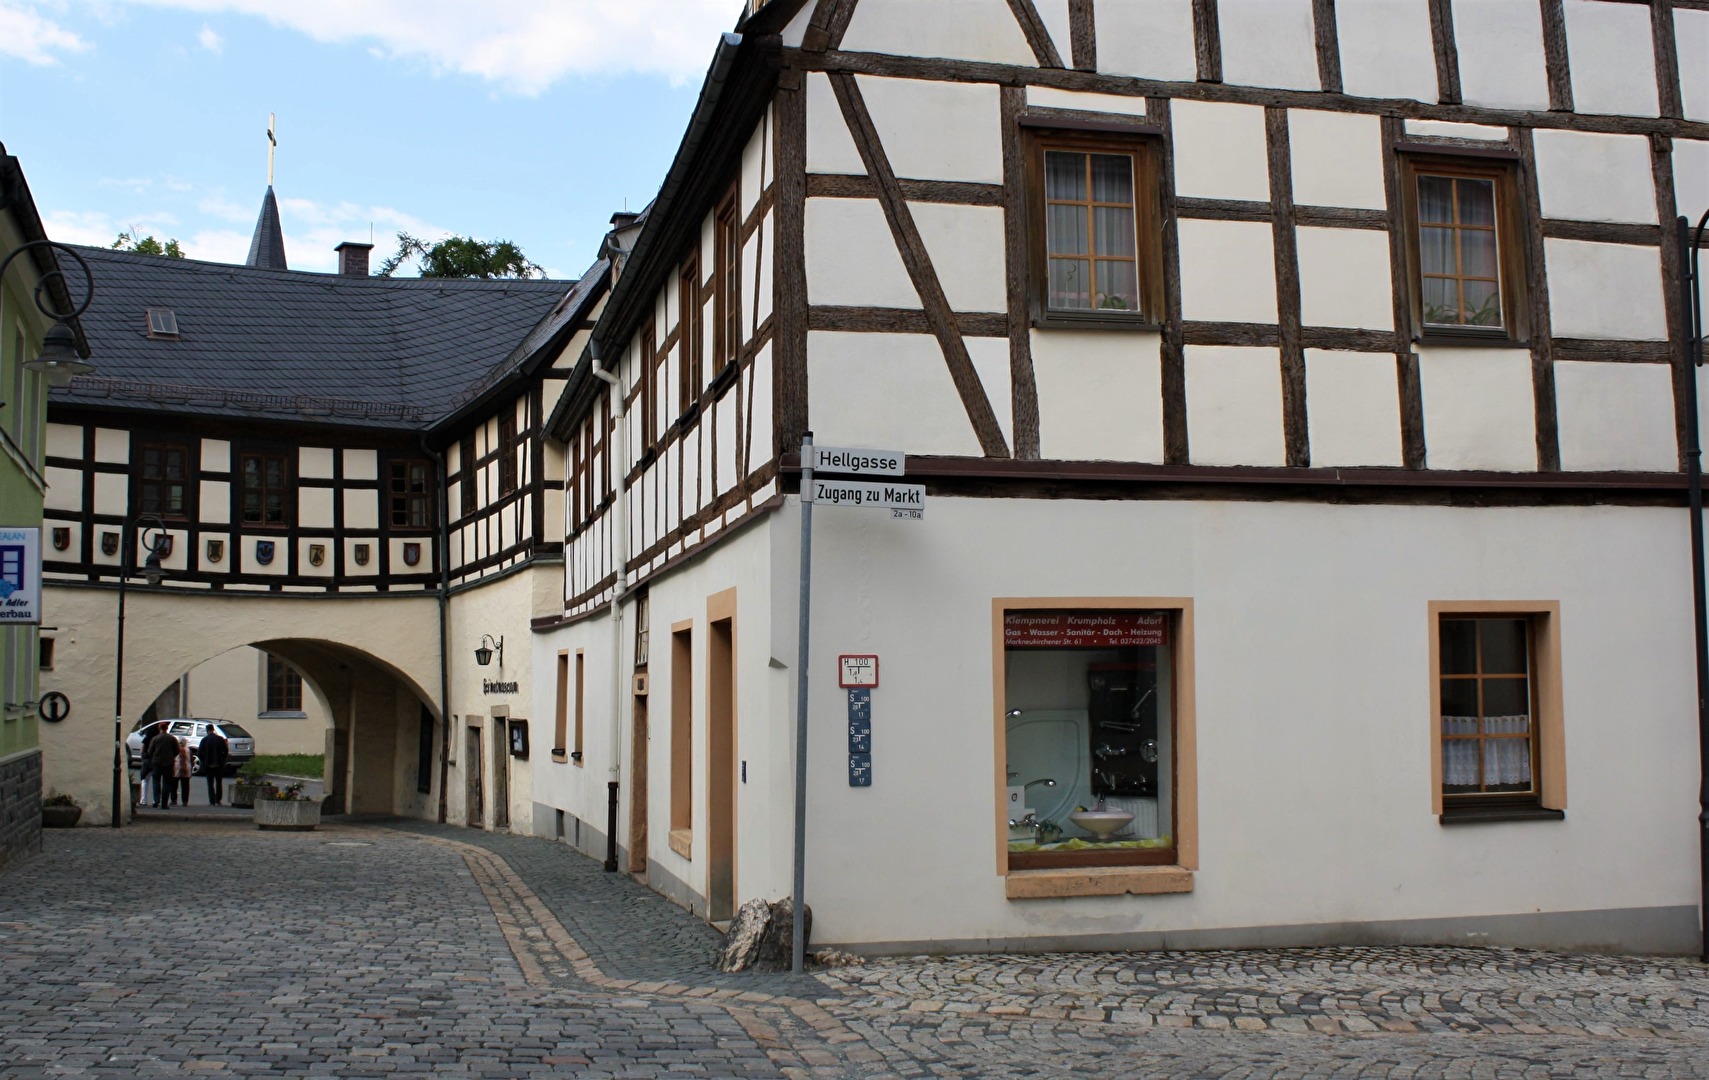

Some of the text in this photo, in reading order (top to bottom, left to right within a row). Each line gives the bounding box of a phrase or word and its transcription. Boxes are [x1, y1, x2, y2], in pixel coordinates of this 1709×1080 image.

[820, 451, 897, 471] Hellgasse
[818, 484, 920, 504] Zugang zu Markt
[893, 510, 903, 518] 2a
[909, 511, 921, 519] 10a
[6, 599, 28, 607] Adler
[1006, 616, 1162, 626] Klempnerei Krumpholz Adorf
[1005, 628, 1021, 636] Gas
[1029, 628, 1059, 636] Wasser
[1066, 628, 1095, 636] Sanitär
[1103, 628, 1123, 636] Dach
[1130, 628, 1162, 637] Heizung
[844, 658, 869, 666] H 100
[850, 694, 855, 702] S
[850, 726, 855, 735] S
[850, 759, 856, 768] S
